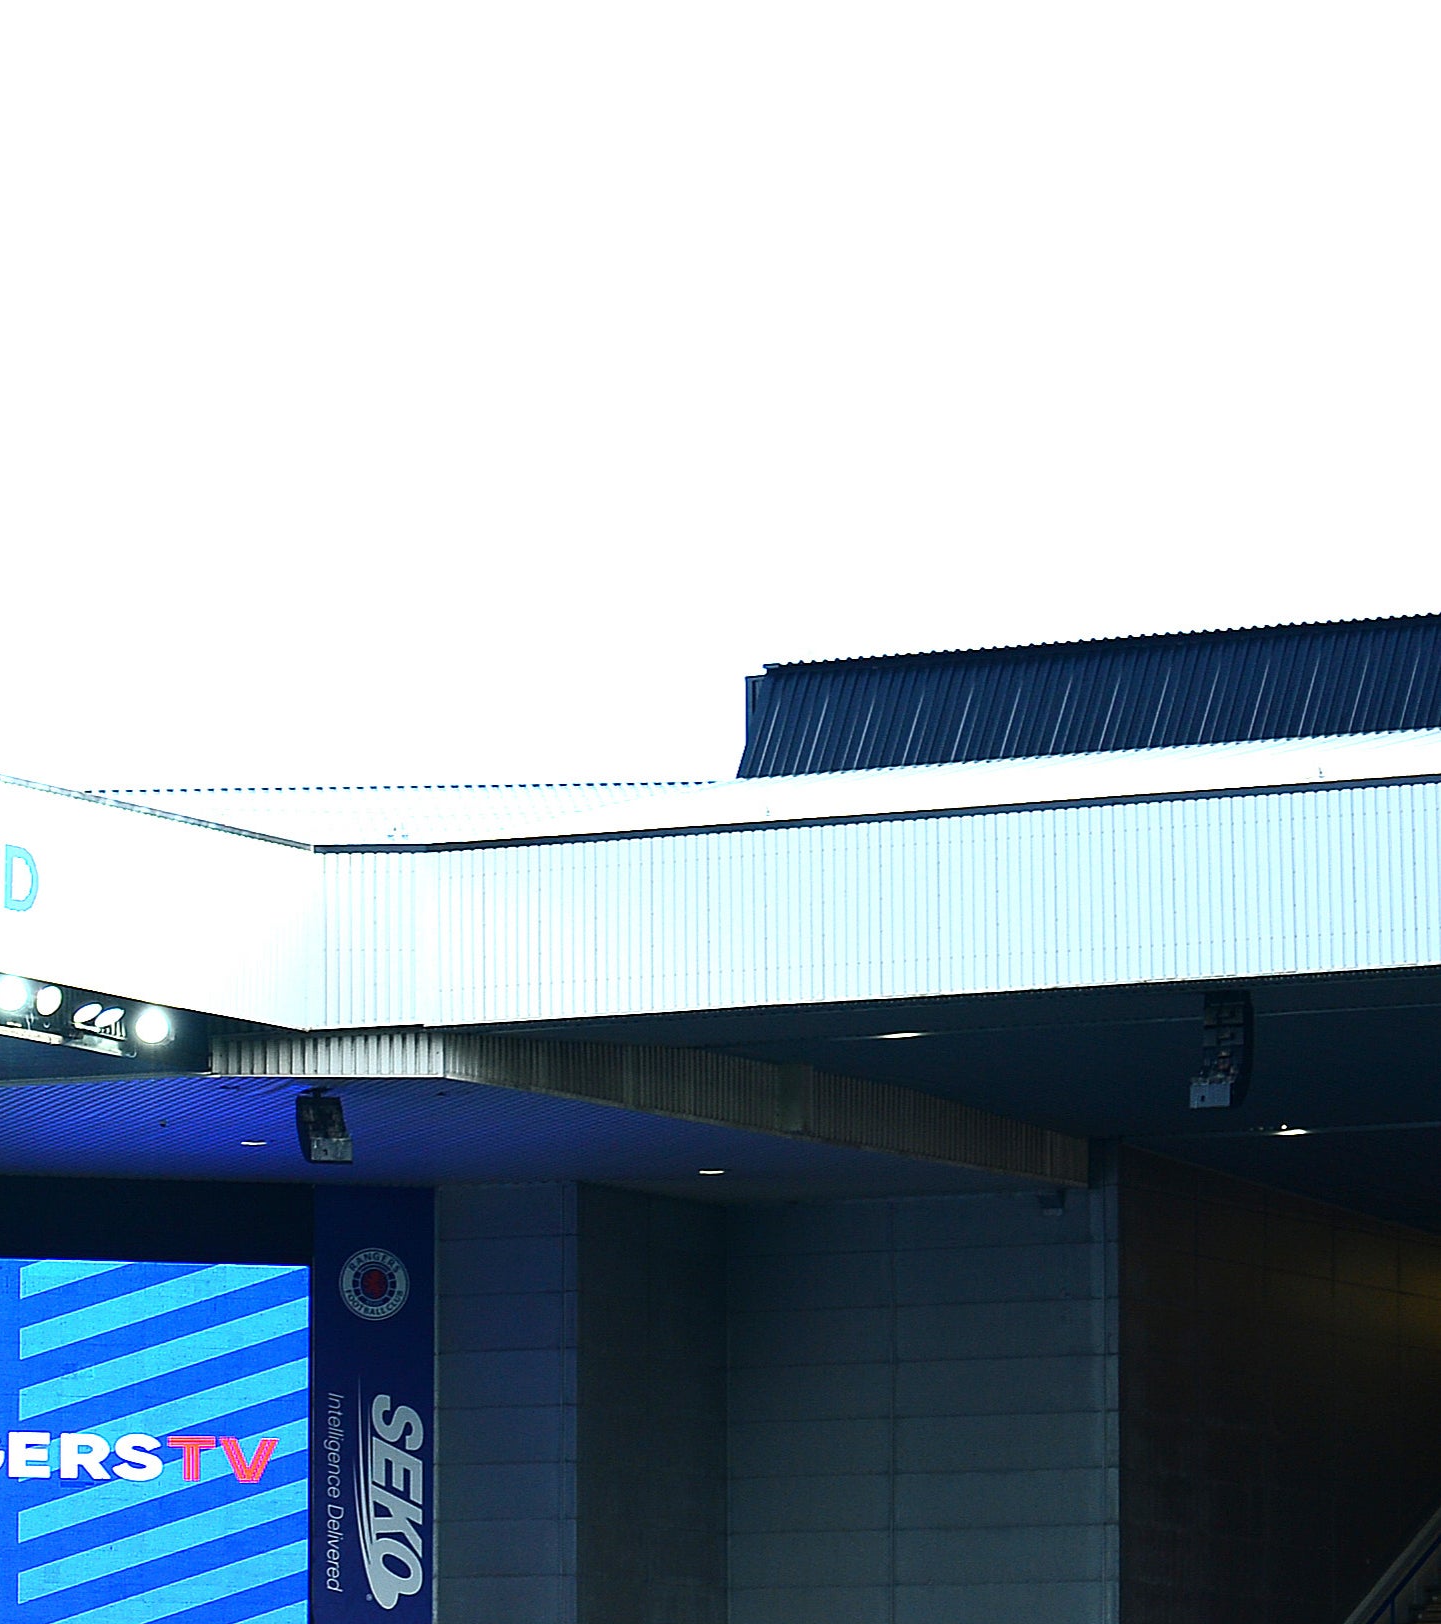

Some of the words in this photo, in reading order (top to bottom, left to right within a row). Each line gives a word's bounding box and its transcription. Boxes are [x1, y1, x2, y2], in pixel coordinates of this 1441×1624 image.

[349, 1251, 400, 1273] RANGERS
[323, 1392, 344, 1498] Intelligence
[326, 1502, 344, 1592] Delivered
[371, 1394, 424, 1610] SEKO
